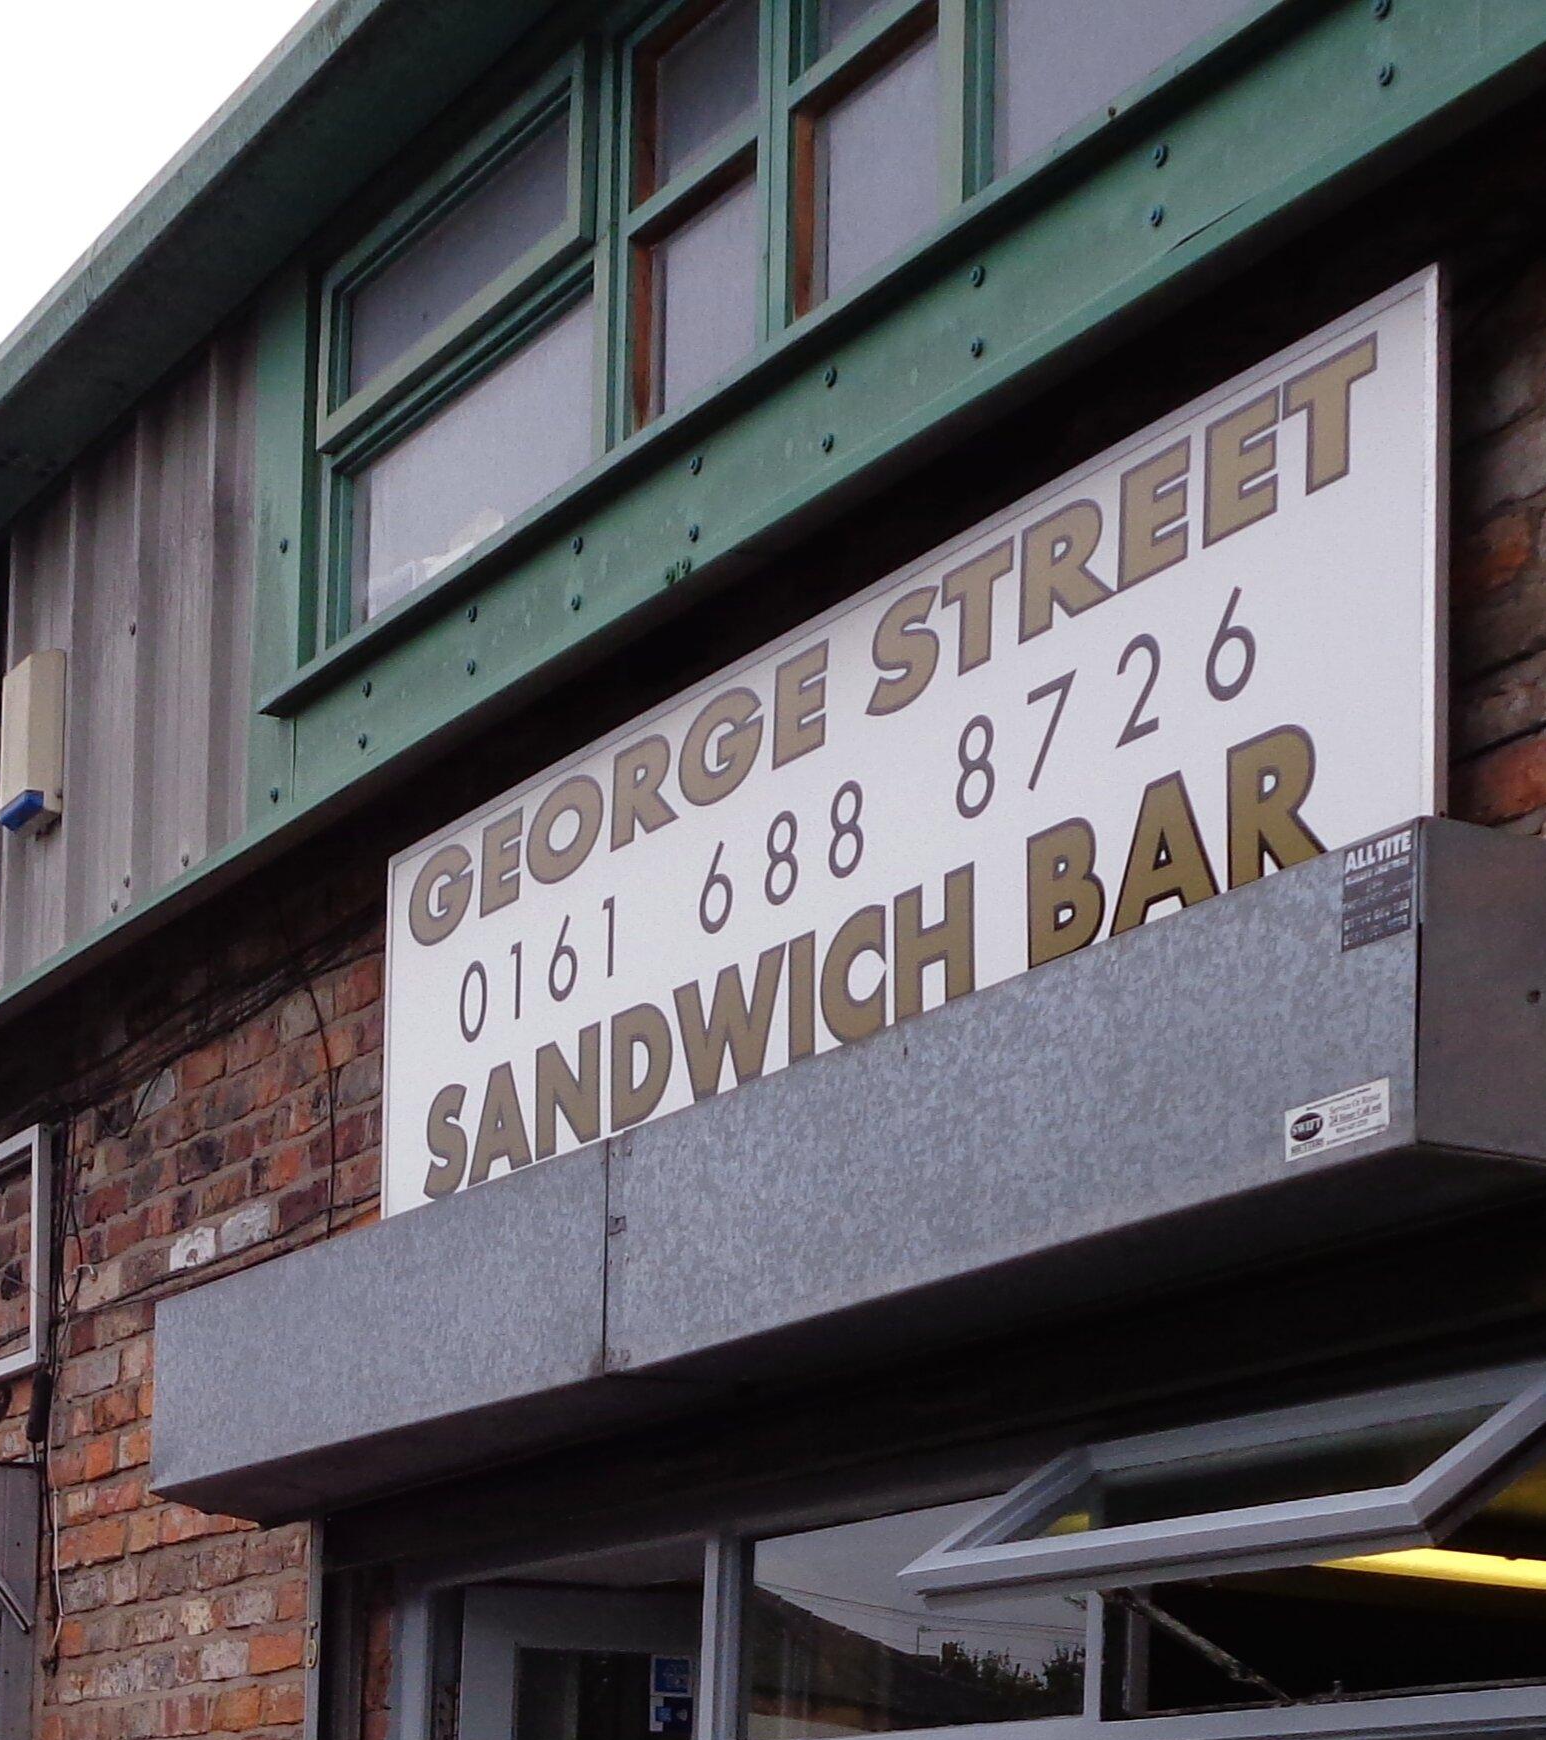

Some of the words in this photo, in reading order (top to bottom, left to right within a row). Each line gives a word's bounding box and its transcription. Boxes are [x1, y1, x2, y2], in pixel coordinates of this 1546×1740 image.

[408, 639, 829, 947] GEORGE
[865, 332, 1378, 716] STREET
[459, 896, 617, 1042] 0161
[699, 780, 864, 935] 688
[955, 586, 1256, 820] 8726
[1344, 829, 1412, 874] ALLTITE
[424, 863, 976, 1201] SANDWICH
[1027, 723, 1329, 970] BAR
[1291, 1117, 1323, 1135] SWIFT
